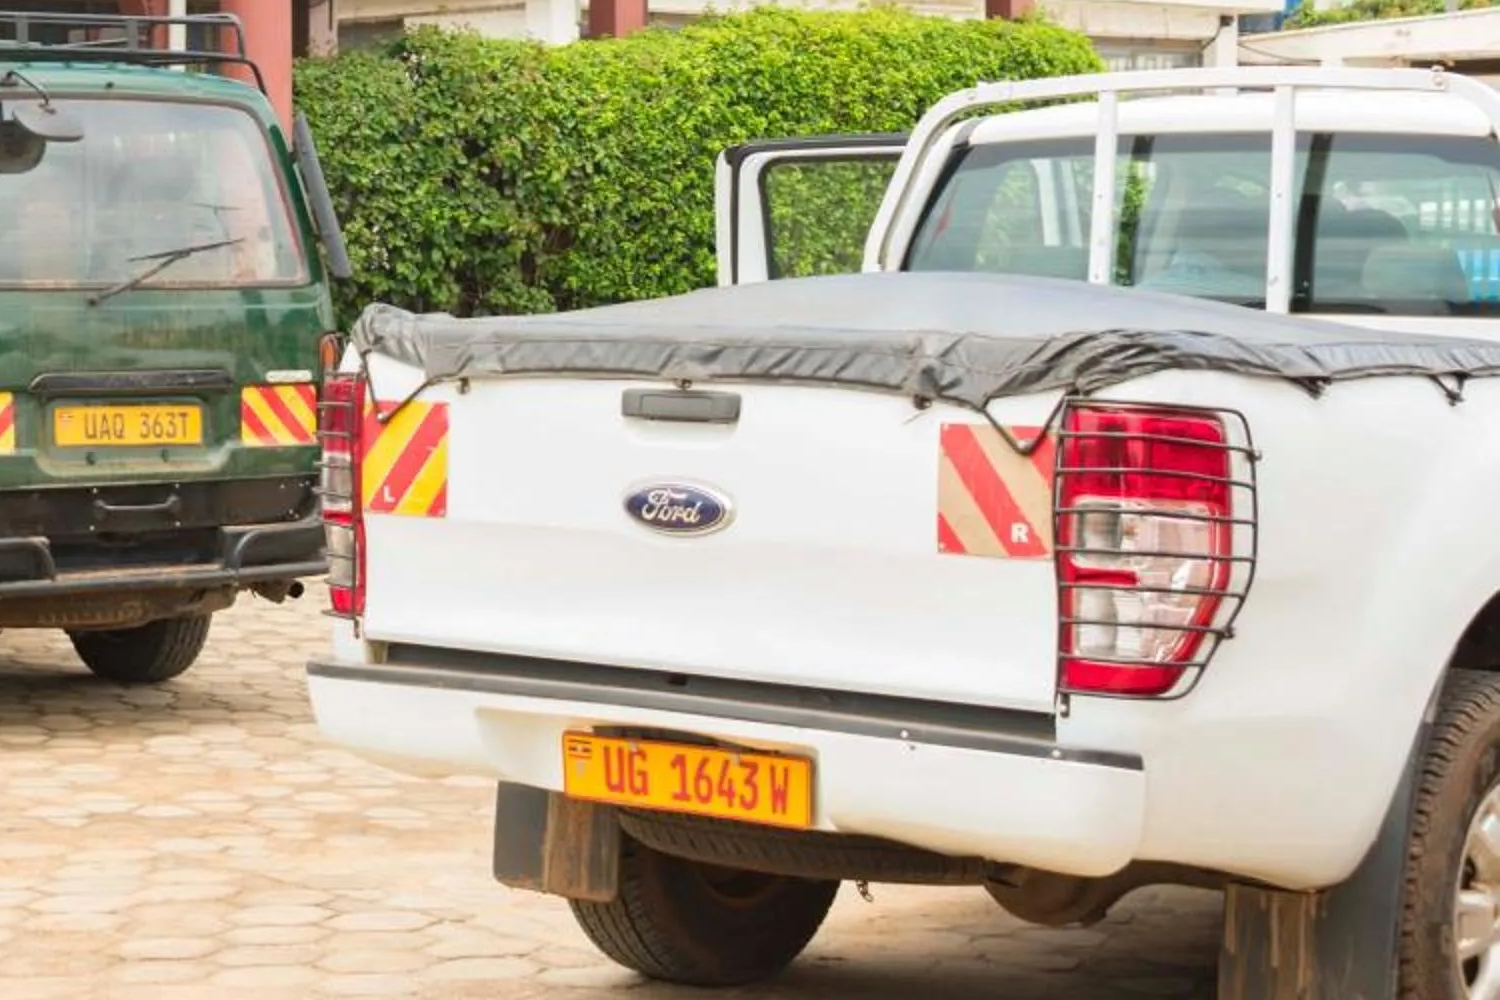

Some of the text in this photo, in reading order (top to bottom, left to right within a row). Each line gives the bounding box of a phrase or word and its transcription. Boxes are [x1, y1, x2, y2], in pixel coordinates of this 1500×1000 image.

[84, 411, 188, 440] UAQ 363T
[641, 488, 702, 523] Ford
[1011, 522, 1029, 543] R
[602, 744, 649, 796] UG
